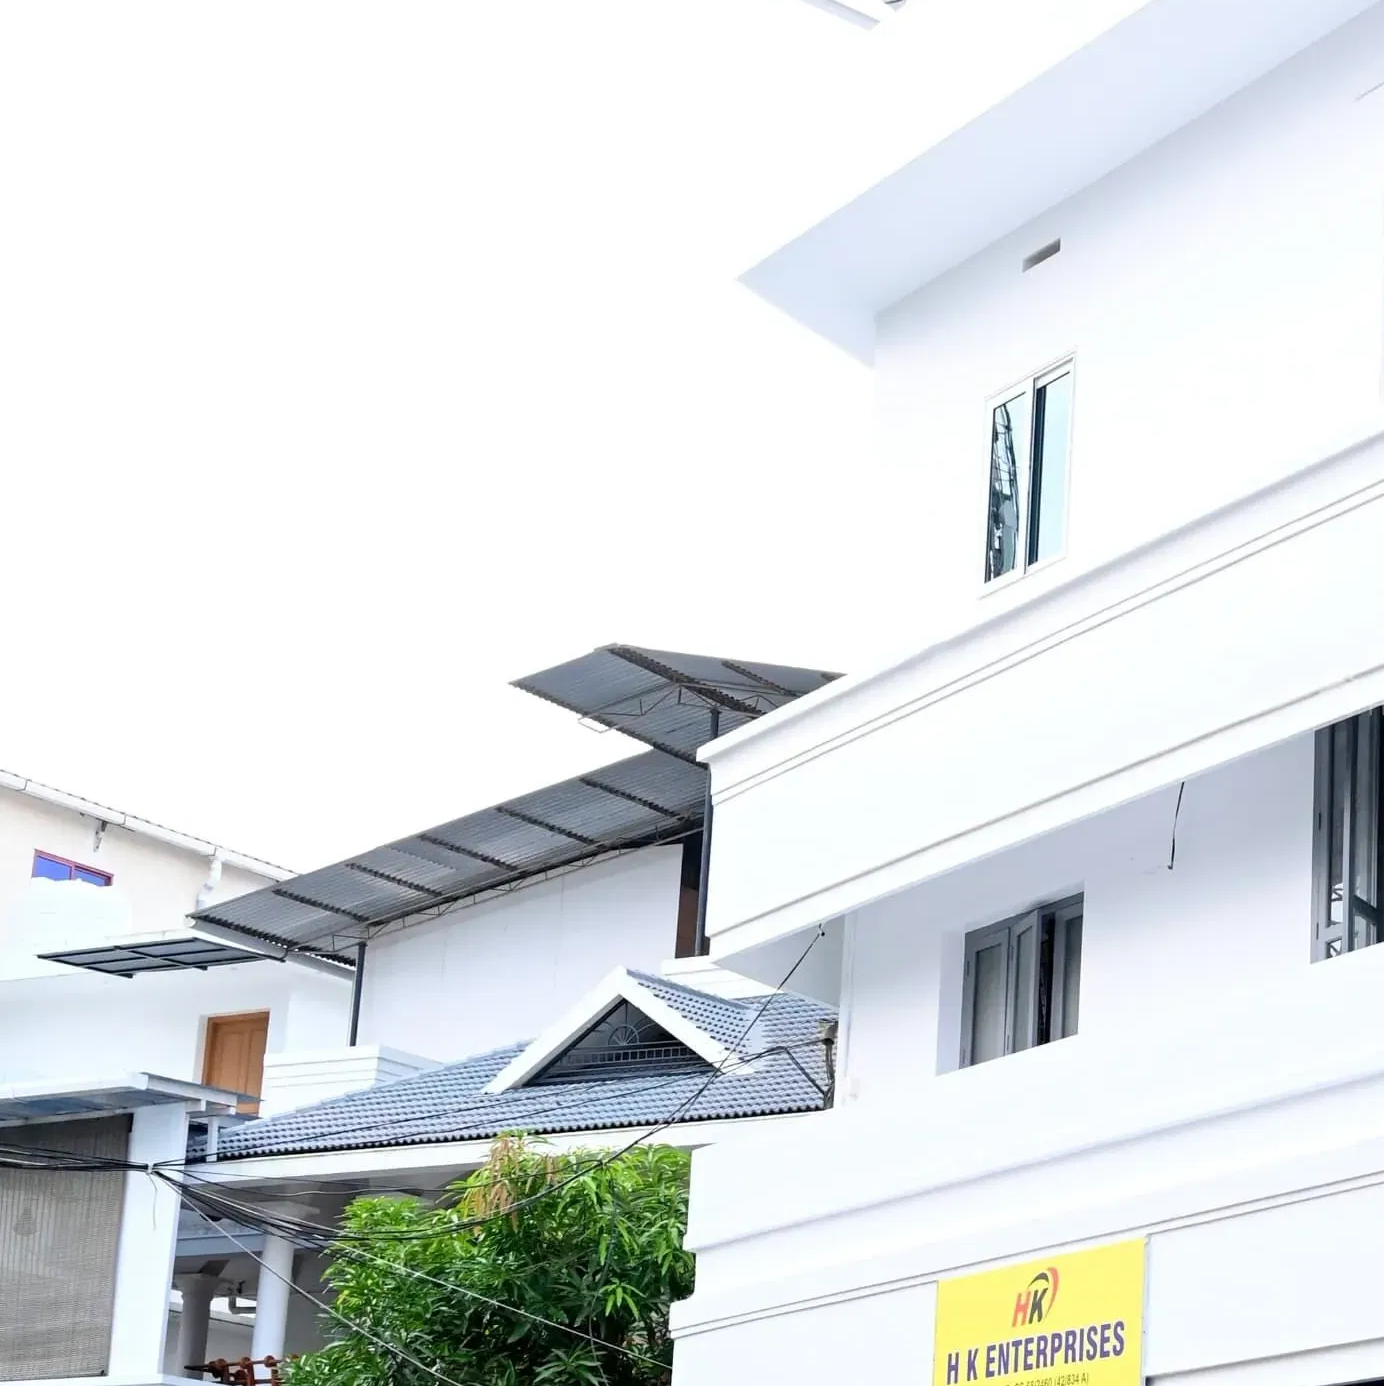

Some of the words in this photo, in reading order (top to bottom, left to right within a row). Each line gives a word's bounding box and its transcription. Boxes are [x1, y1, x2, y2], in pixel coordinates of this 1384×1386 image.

[1011, 1287, 1049, 1329] HK
[946, 1351, 959, 1386] H
[966, 1347, 979, 1382] K
[985, 1320, 1125, 1379] ENTERPRISES
